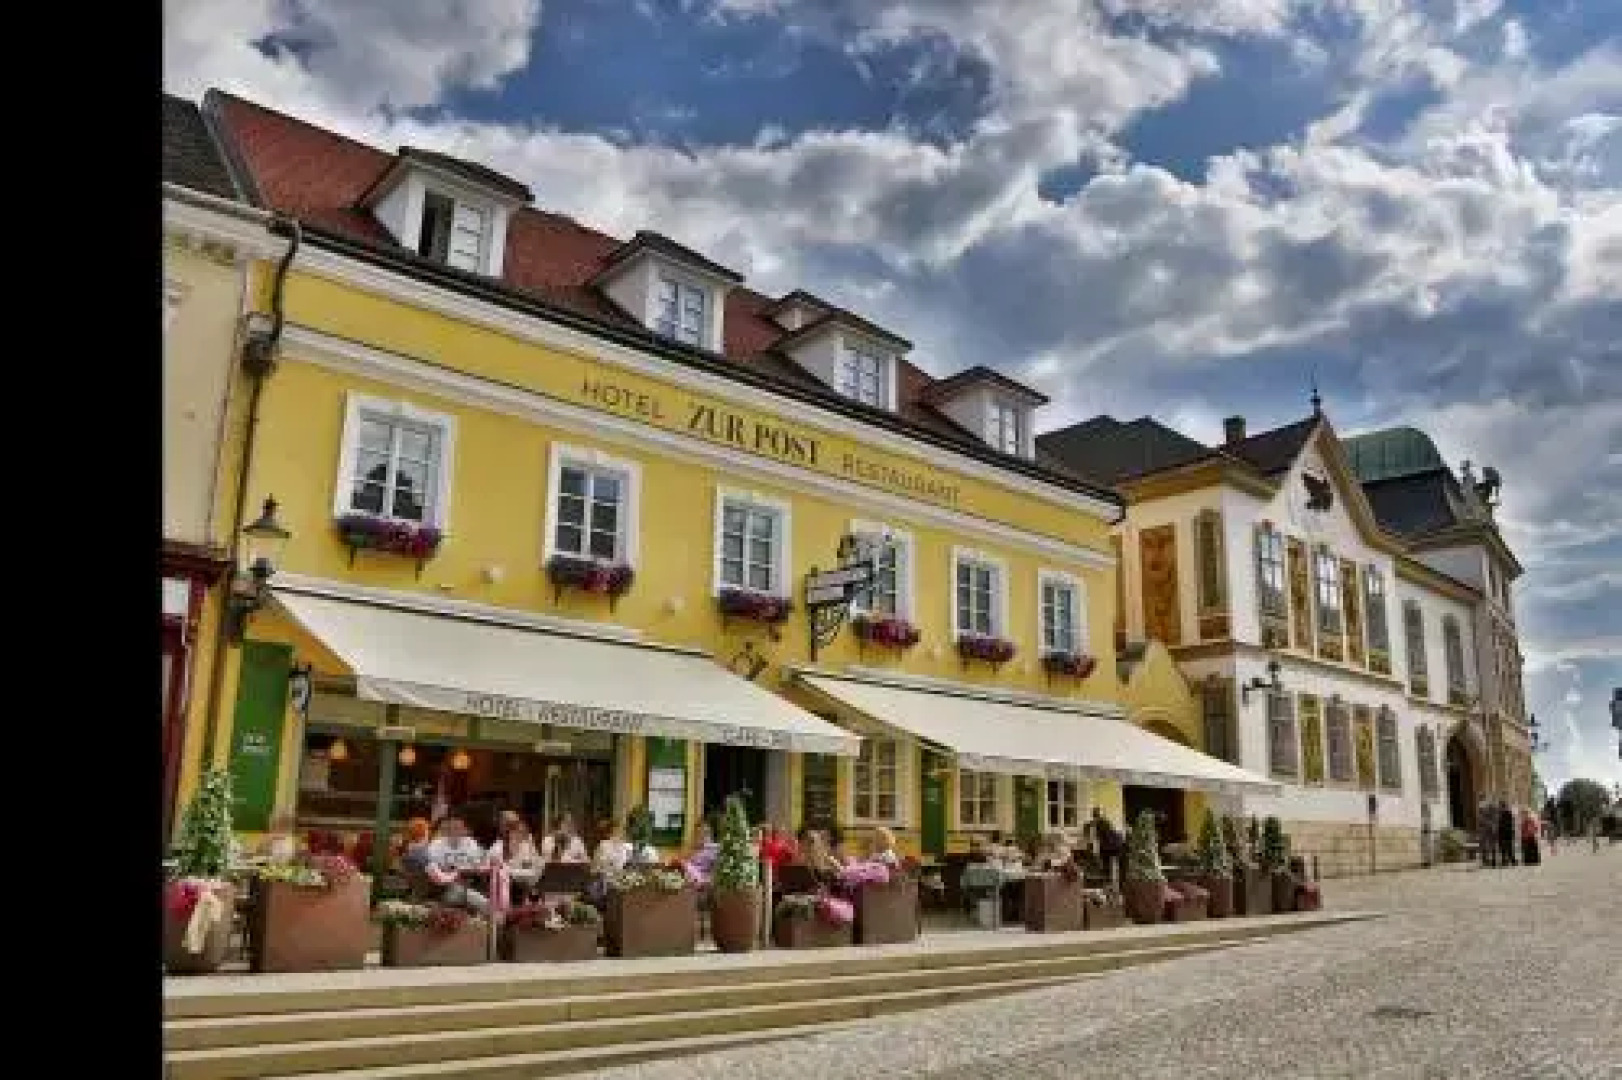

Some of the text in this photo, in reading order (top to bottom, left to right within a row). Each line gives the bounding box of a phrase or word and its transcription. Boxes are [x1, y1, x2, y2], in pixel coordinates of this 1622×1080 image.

[581, 376, 665, 420] HOTEL
[687, 400, 745, 446] ZUR
[754, 420, 822, 465] POST
